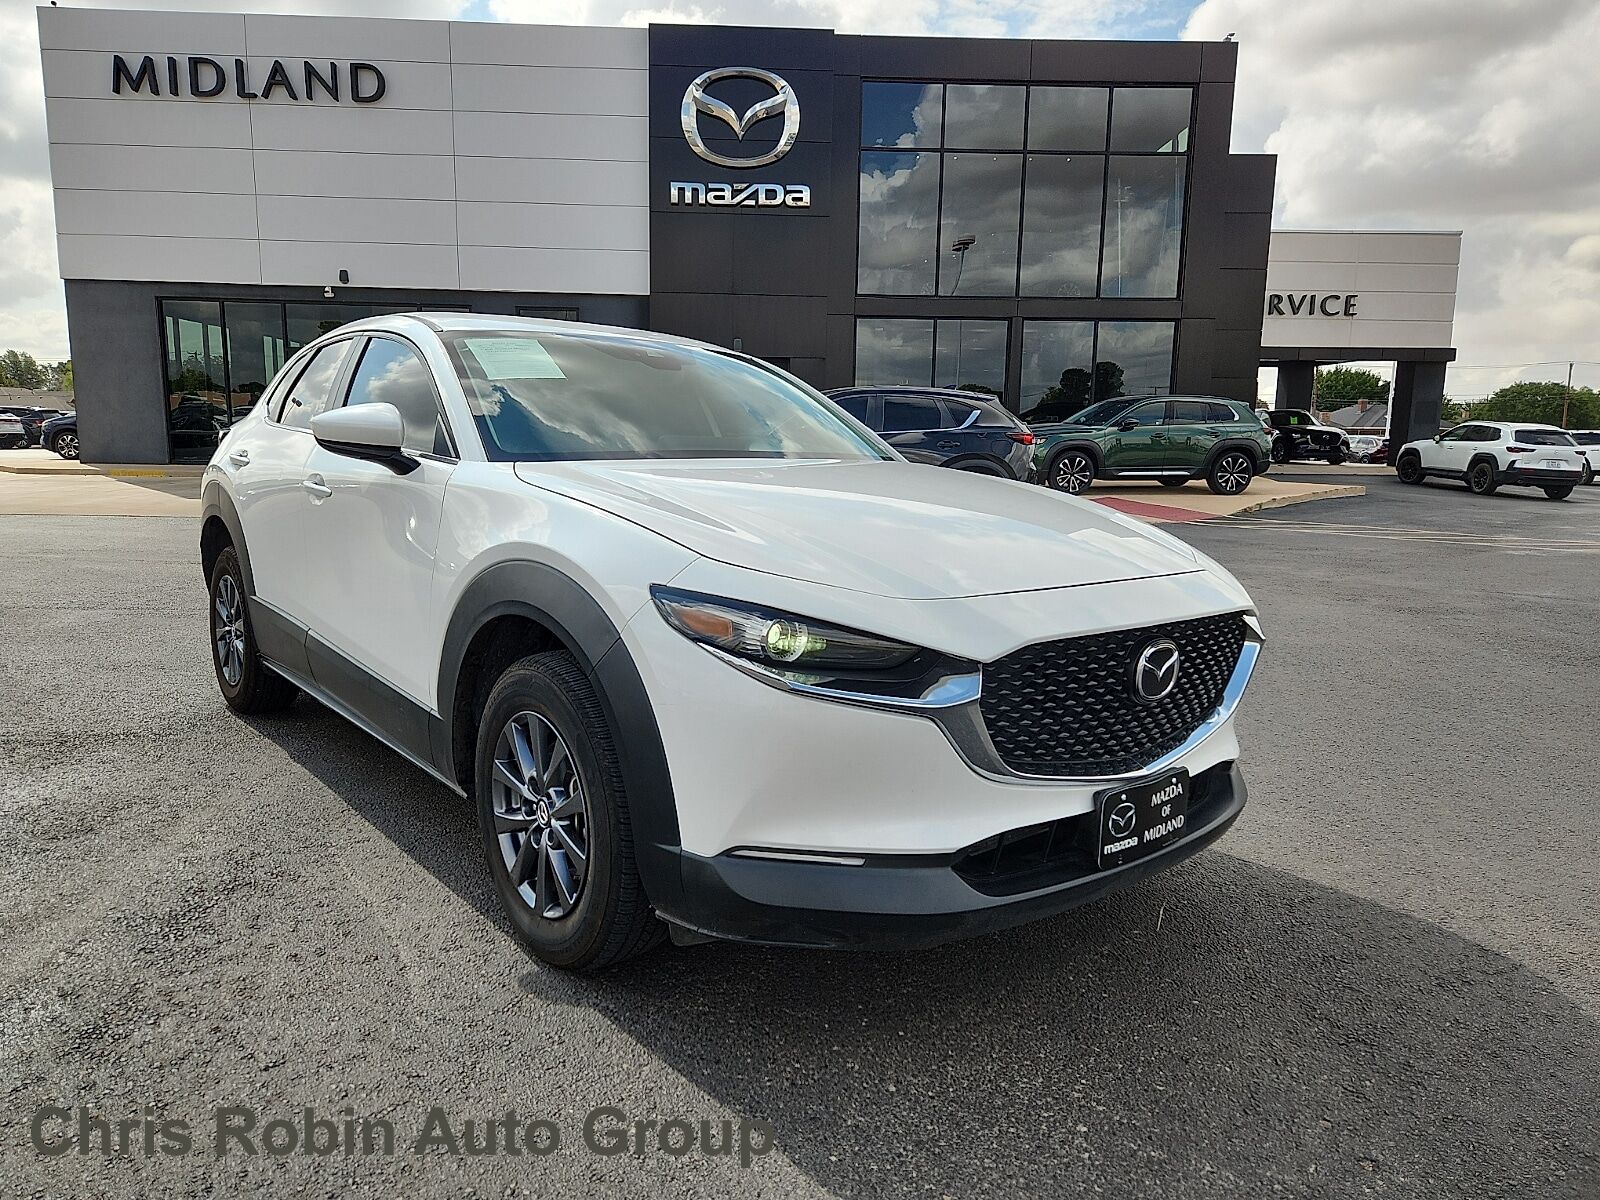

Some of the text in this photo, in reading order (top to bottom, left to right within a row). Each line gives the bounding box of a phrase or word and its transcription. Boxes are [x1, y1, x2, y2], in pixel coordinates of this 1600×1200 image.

[112, 54, 386, 104] MIDLAND
[670, 181, 811, 207] mazda
[1267, 293, 1359, 317] RVICE
[1151, 783, 1183, 807] MAZDA
[1161, 804, 1171, 817] OF
[1143, 815, 1184, 843] MIDLAND
[1104, 836, 1138, 854] mazda
